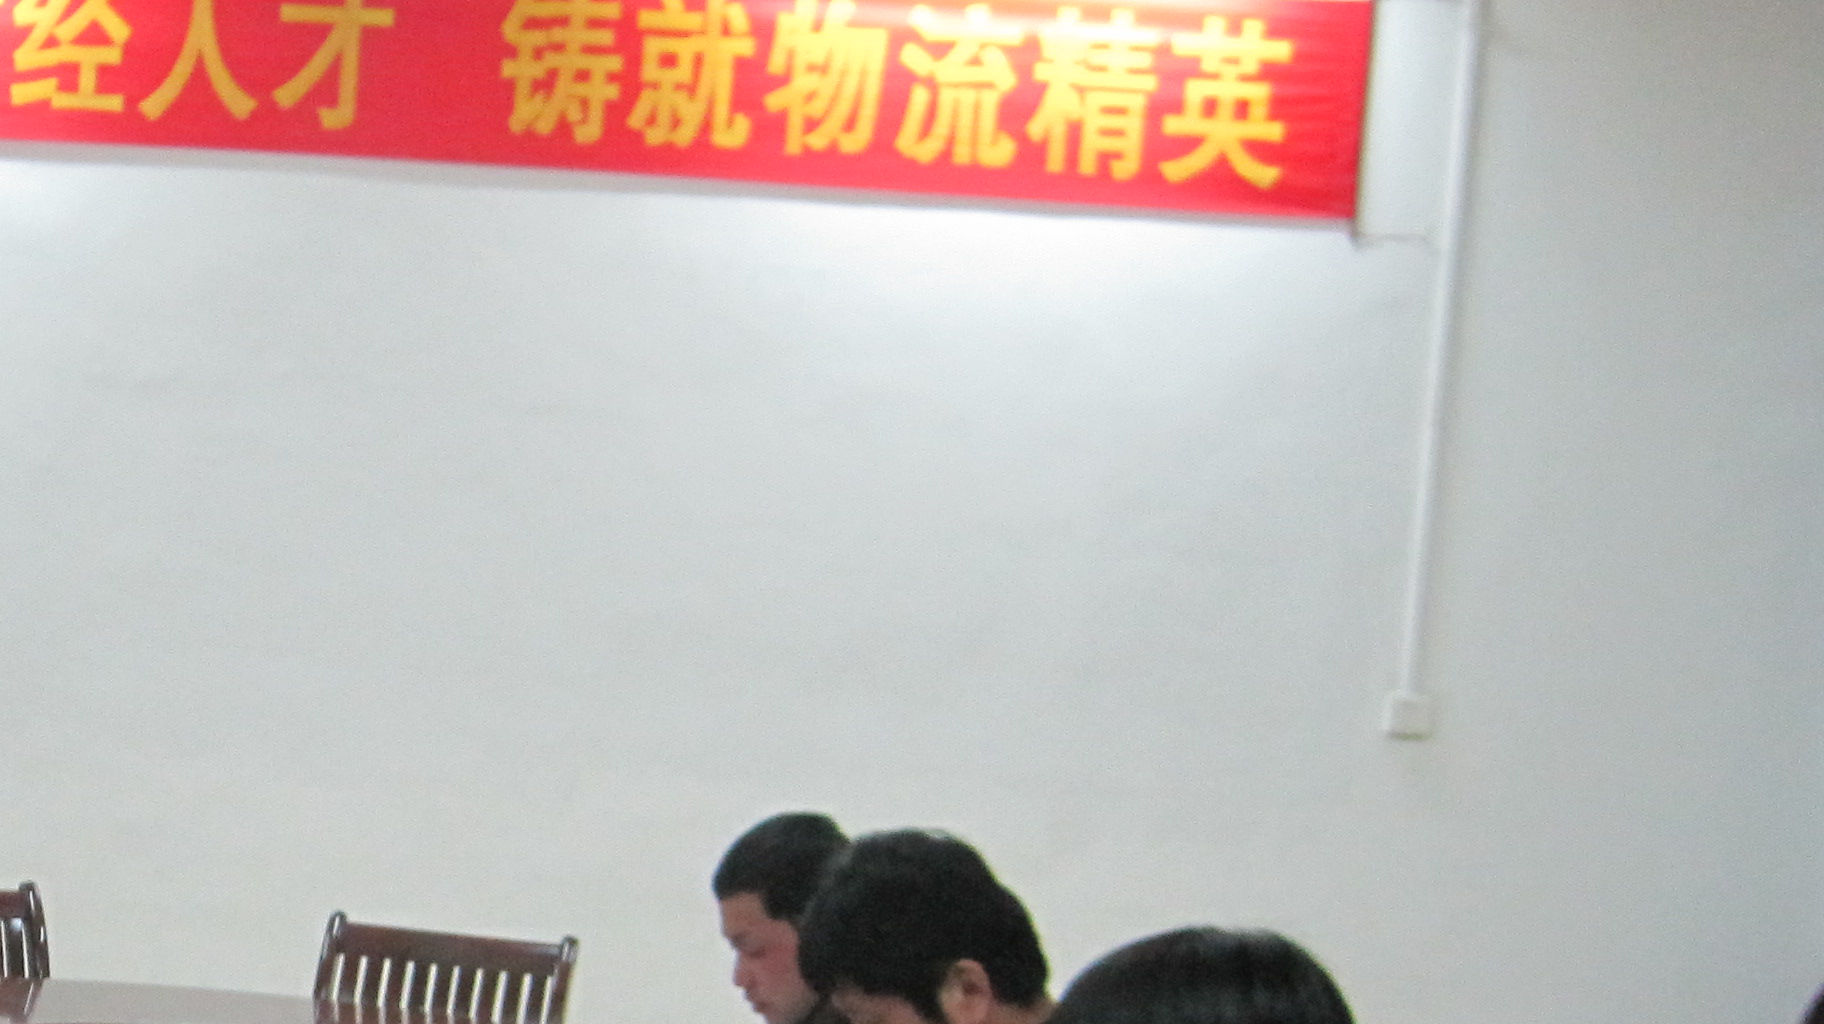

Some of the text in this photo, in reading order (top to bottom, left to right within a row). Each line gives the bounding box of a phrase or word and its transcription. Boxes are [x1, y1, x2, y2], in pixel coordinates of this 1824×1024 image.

[499, 2, 1294, 190] 铸就物流精英
